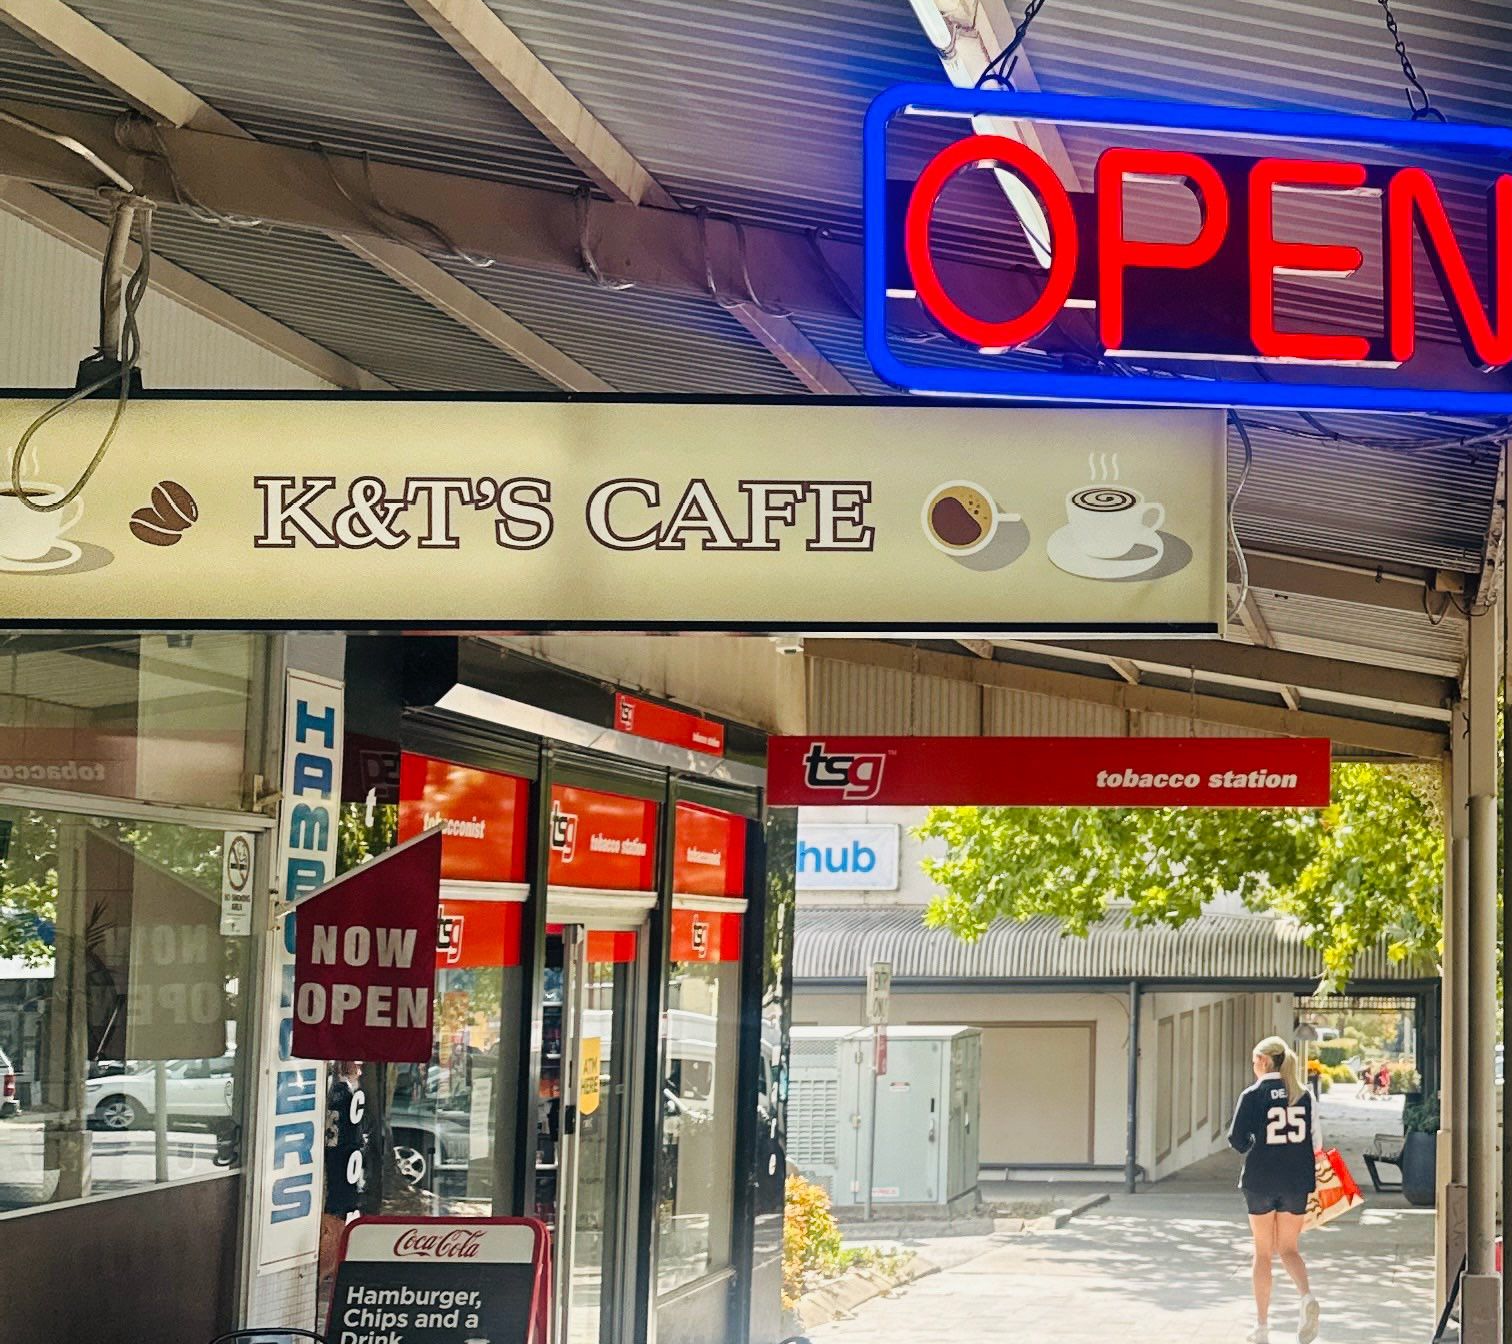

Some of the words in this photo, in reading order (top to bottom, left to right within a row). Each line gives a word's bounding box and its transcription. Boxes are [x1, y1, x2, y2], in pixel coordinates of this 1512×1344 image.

[254, 476, 554, 550] K&T'S
[585, 477, 876, 551] CAFE
[802, 742, 886, 800] tsg
[1096, 768, 1200, 788] tobacco
[1208, 769, 1298, 789] station
[549, 799, 579, 864] tsg
[796, 840, 876, 873] hub
[270, 699, 335, 1225] HAMBERS
[310, 924, 418, 968] NOW
[297, 982, 429, 1029] OPEN
[1266, 1106, 1306, 1144] 25
[393, 1228, 488, 1258] Coca-Cola
[346, 1285, 482, 1309] Hamburger,
[343, 1308, 408, 1331] Chips
[414, 1309, 460, 1328] and
[464, 1313, 479, 1329] a
